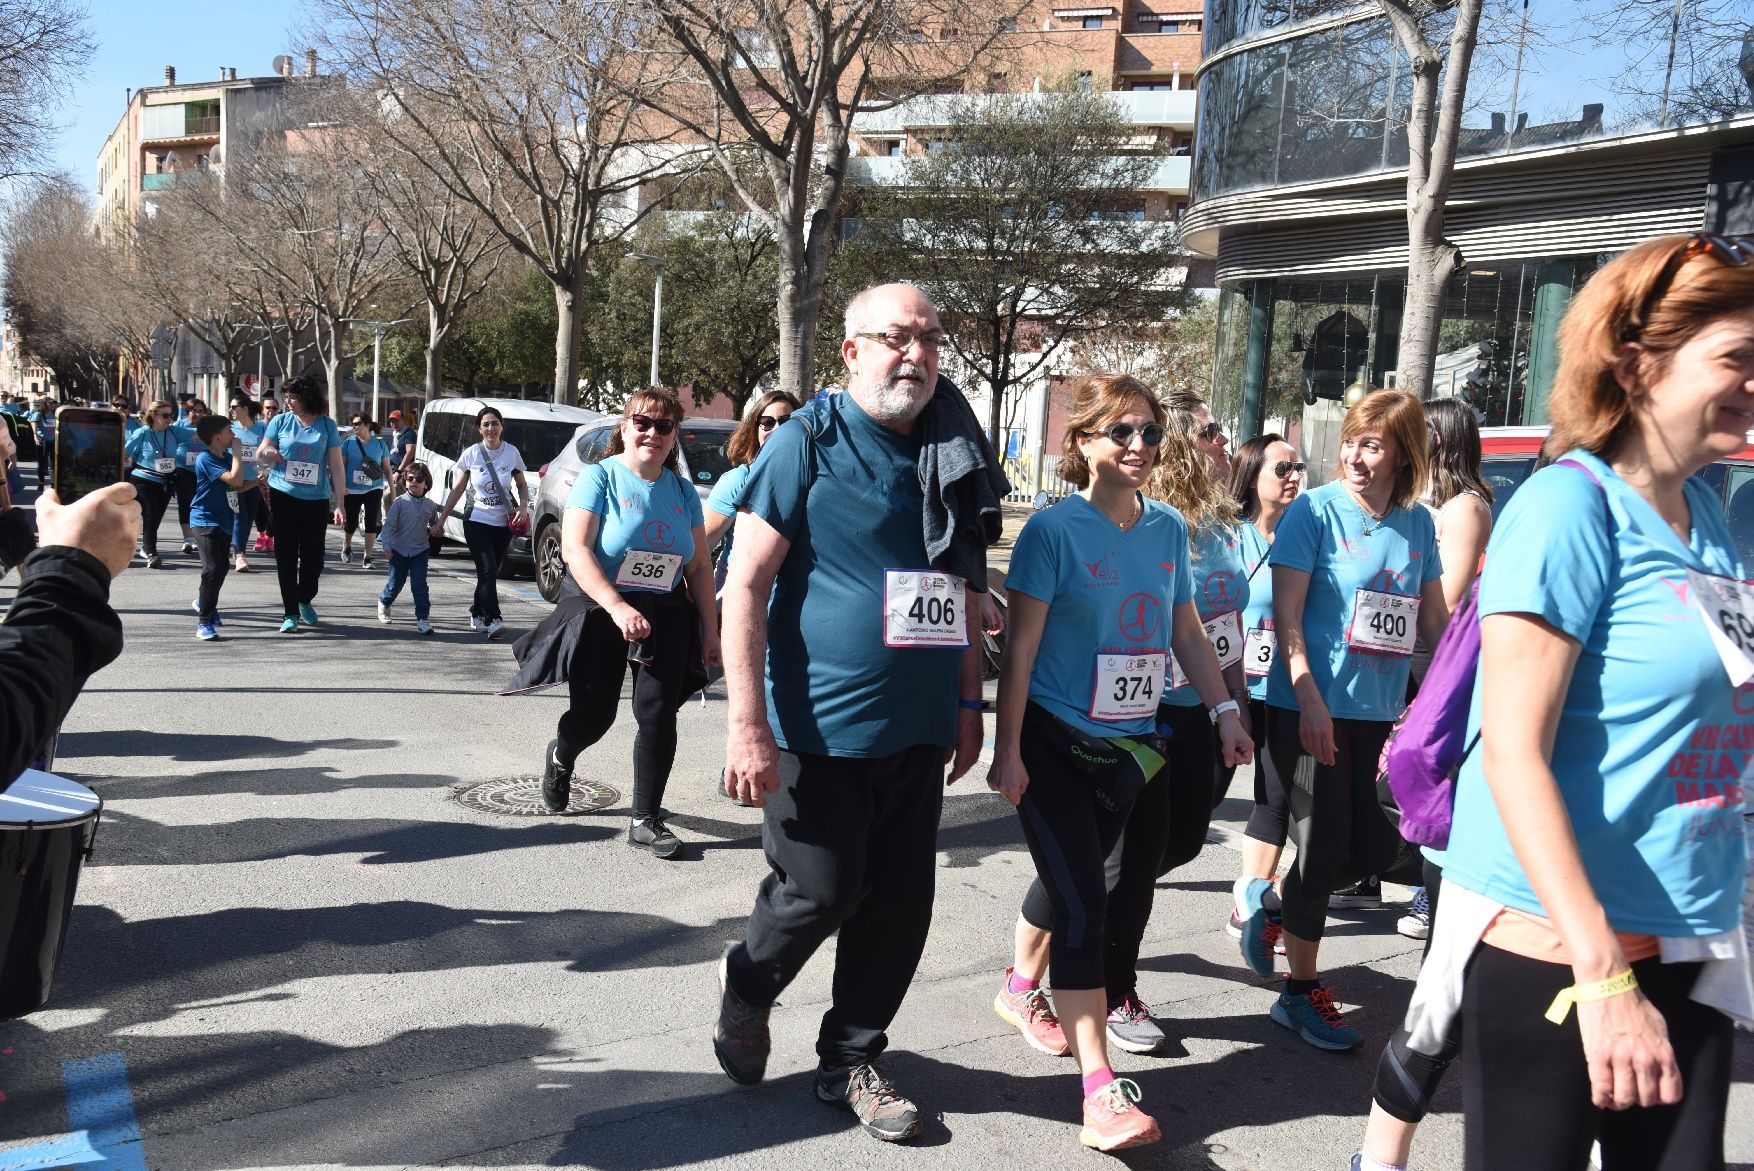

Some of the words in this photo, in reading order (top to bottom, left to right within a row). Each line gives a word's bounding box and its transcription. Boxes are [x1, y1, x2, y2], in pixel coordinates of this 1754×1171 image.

[160, 462, 172, 470] 582
[292, 467, 312, 478] 347
[631, 562, 666, 579] 536
[908, 596, 955, 626] 406
[1369, 611, 1406, 638] 400
[1257, 645, 1271, 662] 3
[1113, 675, 1153, 702] 374
[1721, 722, 1754, 750] CU
[1071, 745, 1118, 764] Quechua
[1667, 752, 1702, 778] DE
[1704, 752, 1740, 779] LA
